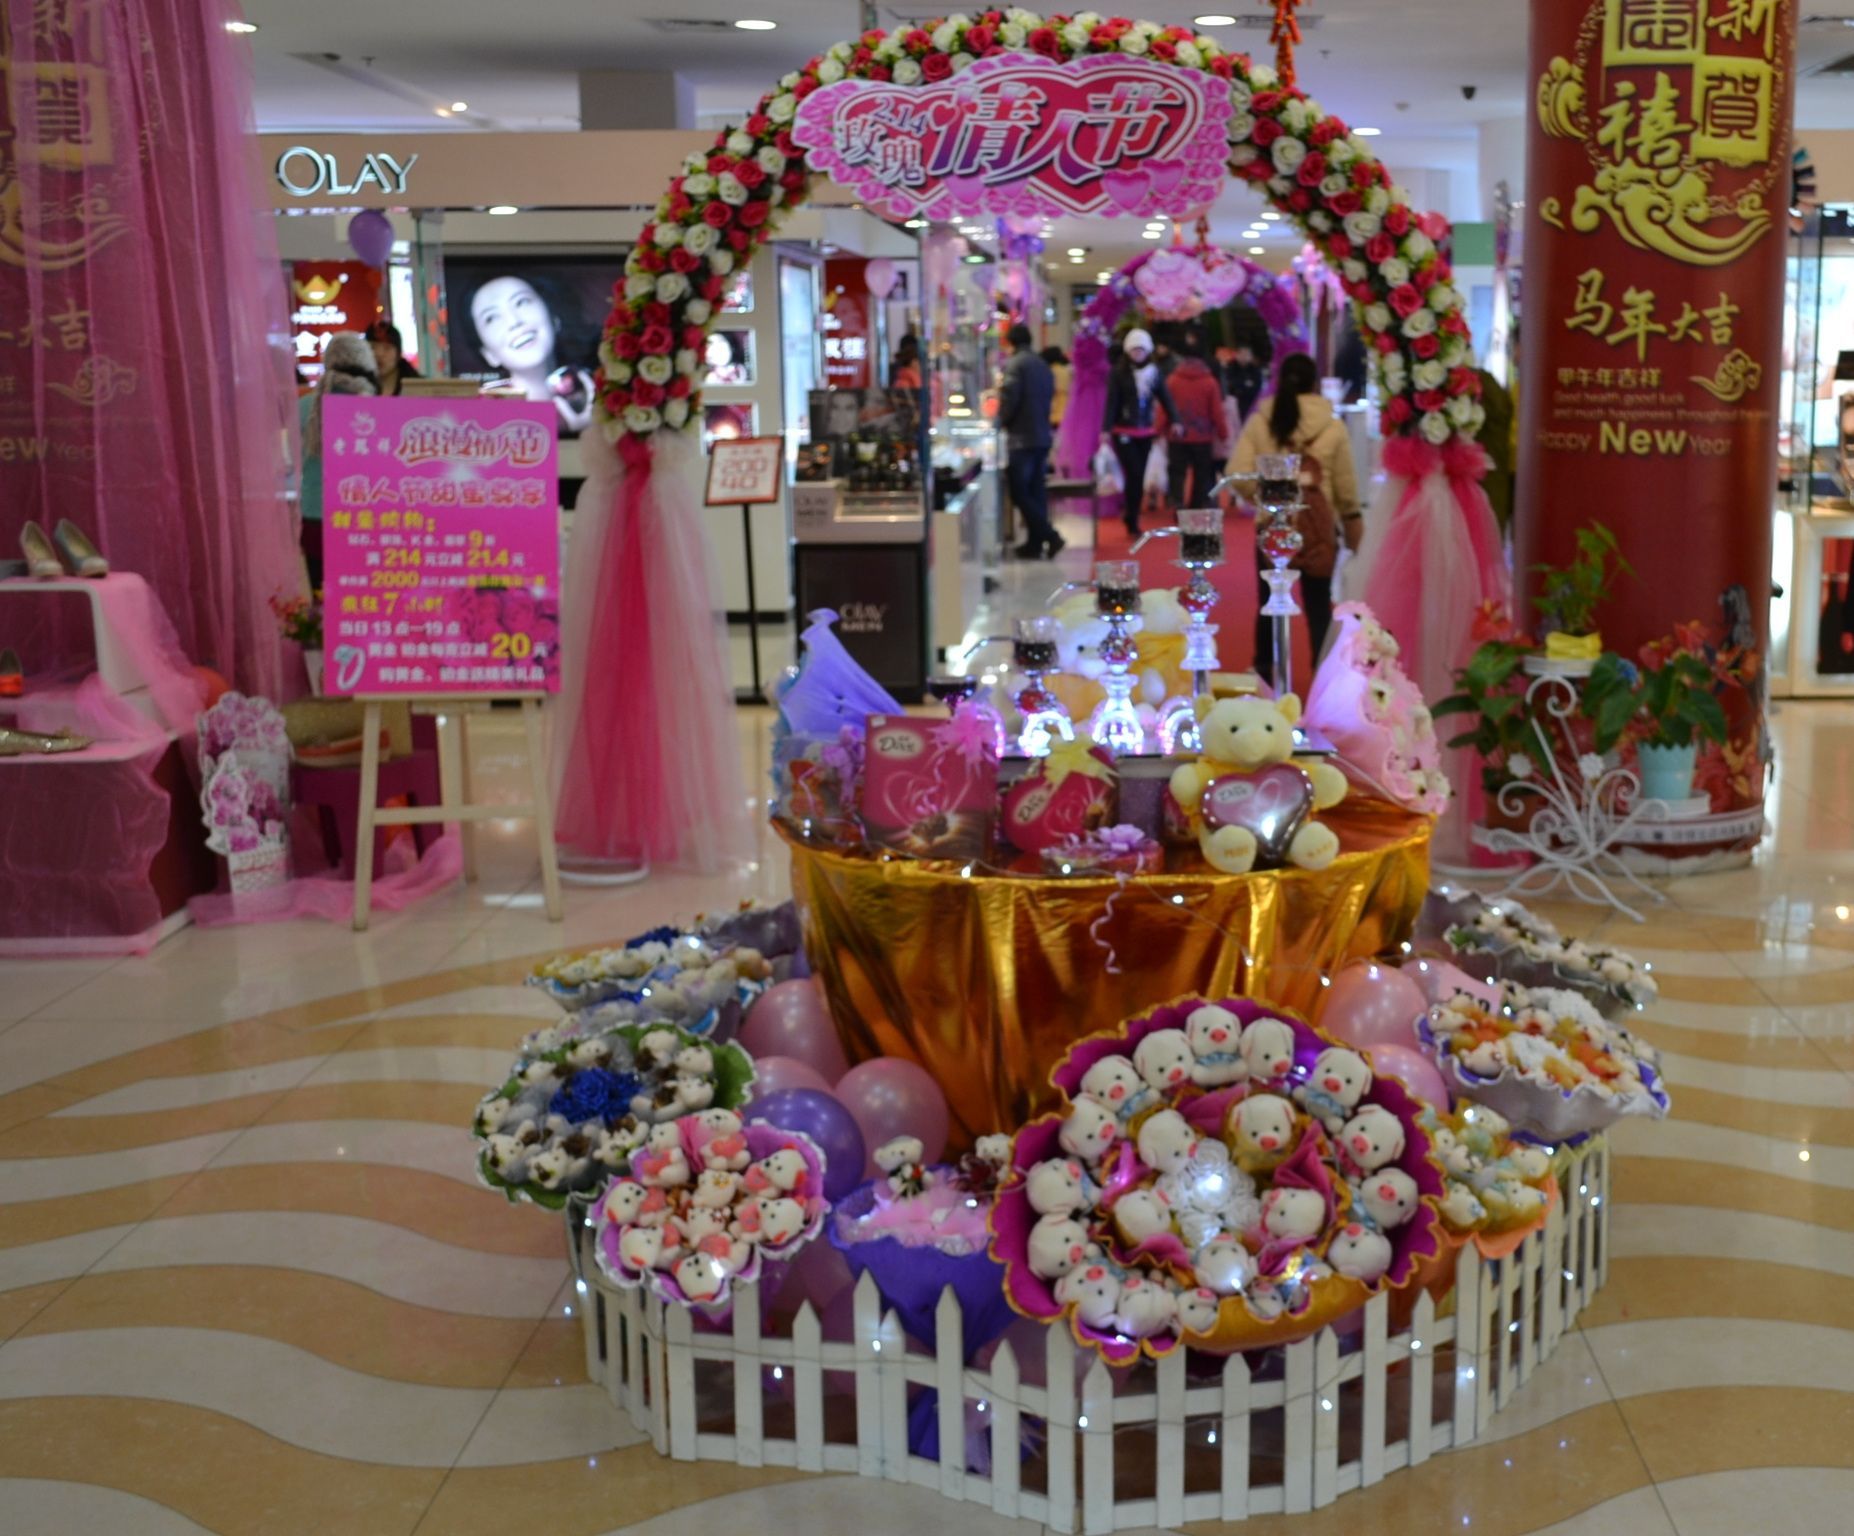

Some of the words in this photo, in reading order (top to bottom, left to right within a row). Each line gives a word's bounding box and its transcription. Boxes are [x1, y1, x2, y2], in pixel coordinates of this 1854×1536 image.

[873, 94, 929, 137] 2.14
[928, 81, 1182, 185] 情人节
[276, 146, 418, 196] OLAY
[840, 115, 926, 185] 玫瑰
[1564, 267, 1740, 363] 马年大吉
[1600, 420, 1689, 455] New
[371, 571, 420, 588] 2000
[384, 549, 421, 567] 214
[467, 549, 509, 568] 21.4
[491, 632, 531, 659] 20
